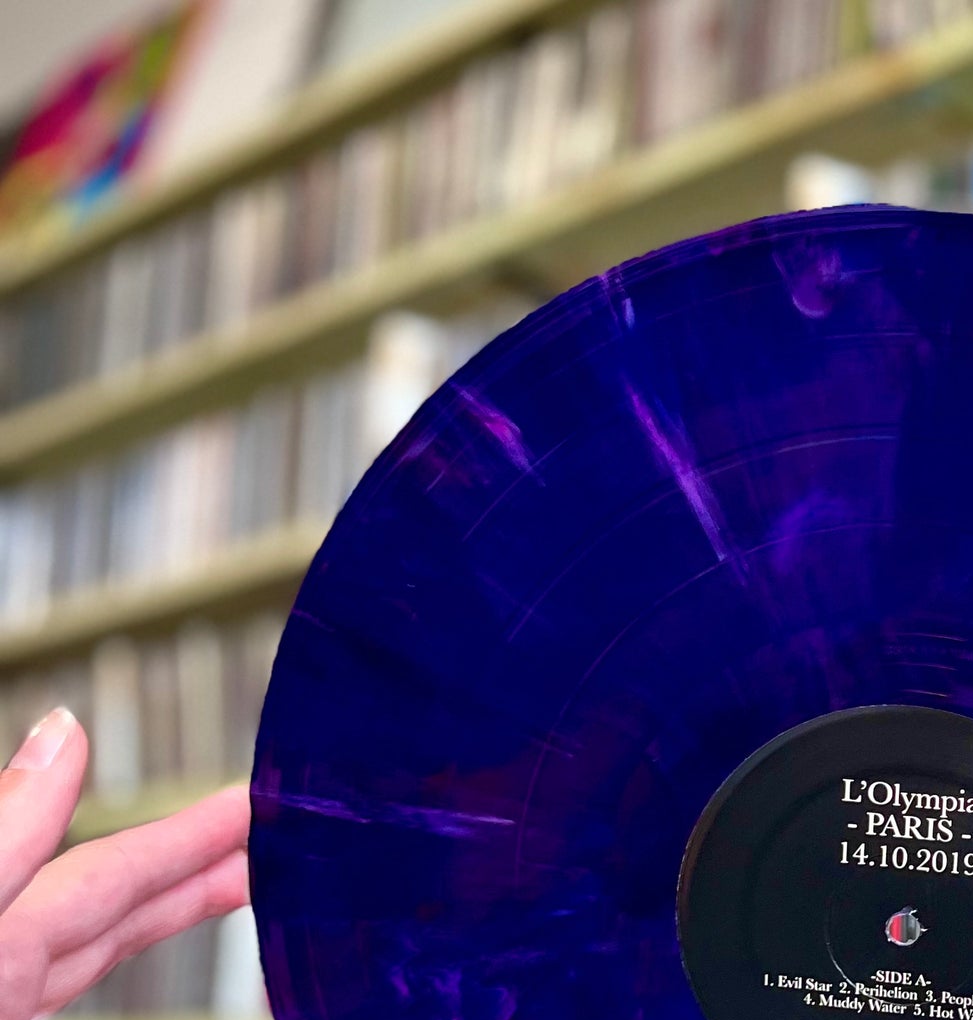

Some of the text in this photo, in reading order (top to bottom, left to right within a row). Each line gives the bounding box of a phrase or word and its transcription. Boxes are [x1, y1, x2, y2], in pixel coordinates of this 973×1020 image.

[865, 812, 953, 843] PARIS
[763, 973, 774, 987] 1.
[777, 975, 802, 991] Evil
[805, 978, 832, 992] Star
[839, 981, 851, 994] 2.
[854, 982, 918, 1001] Perihelion
[925, 990, 938, 1003] 3.
[870, 969, 931, 988] -SIDE A-
[803, 993, 816, 1006] 4.
[818, 995, 865, 1014] Muddy
[868, 999, 907, 1015] Water
[913, 1003, 925, 1017] 5.
[929, 1005, 955, 1020] Hot
